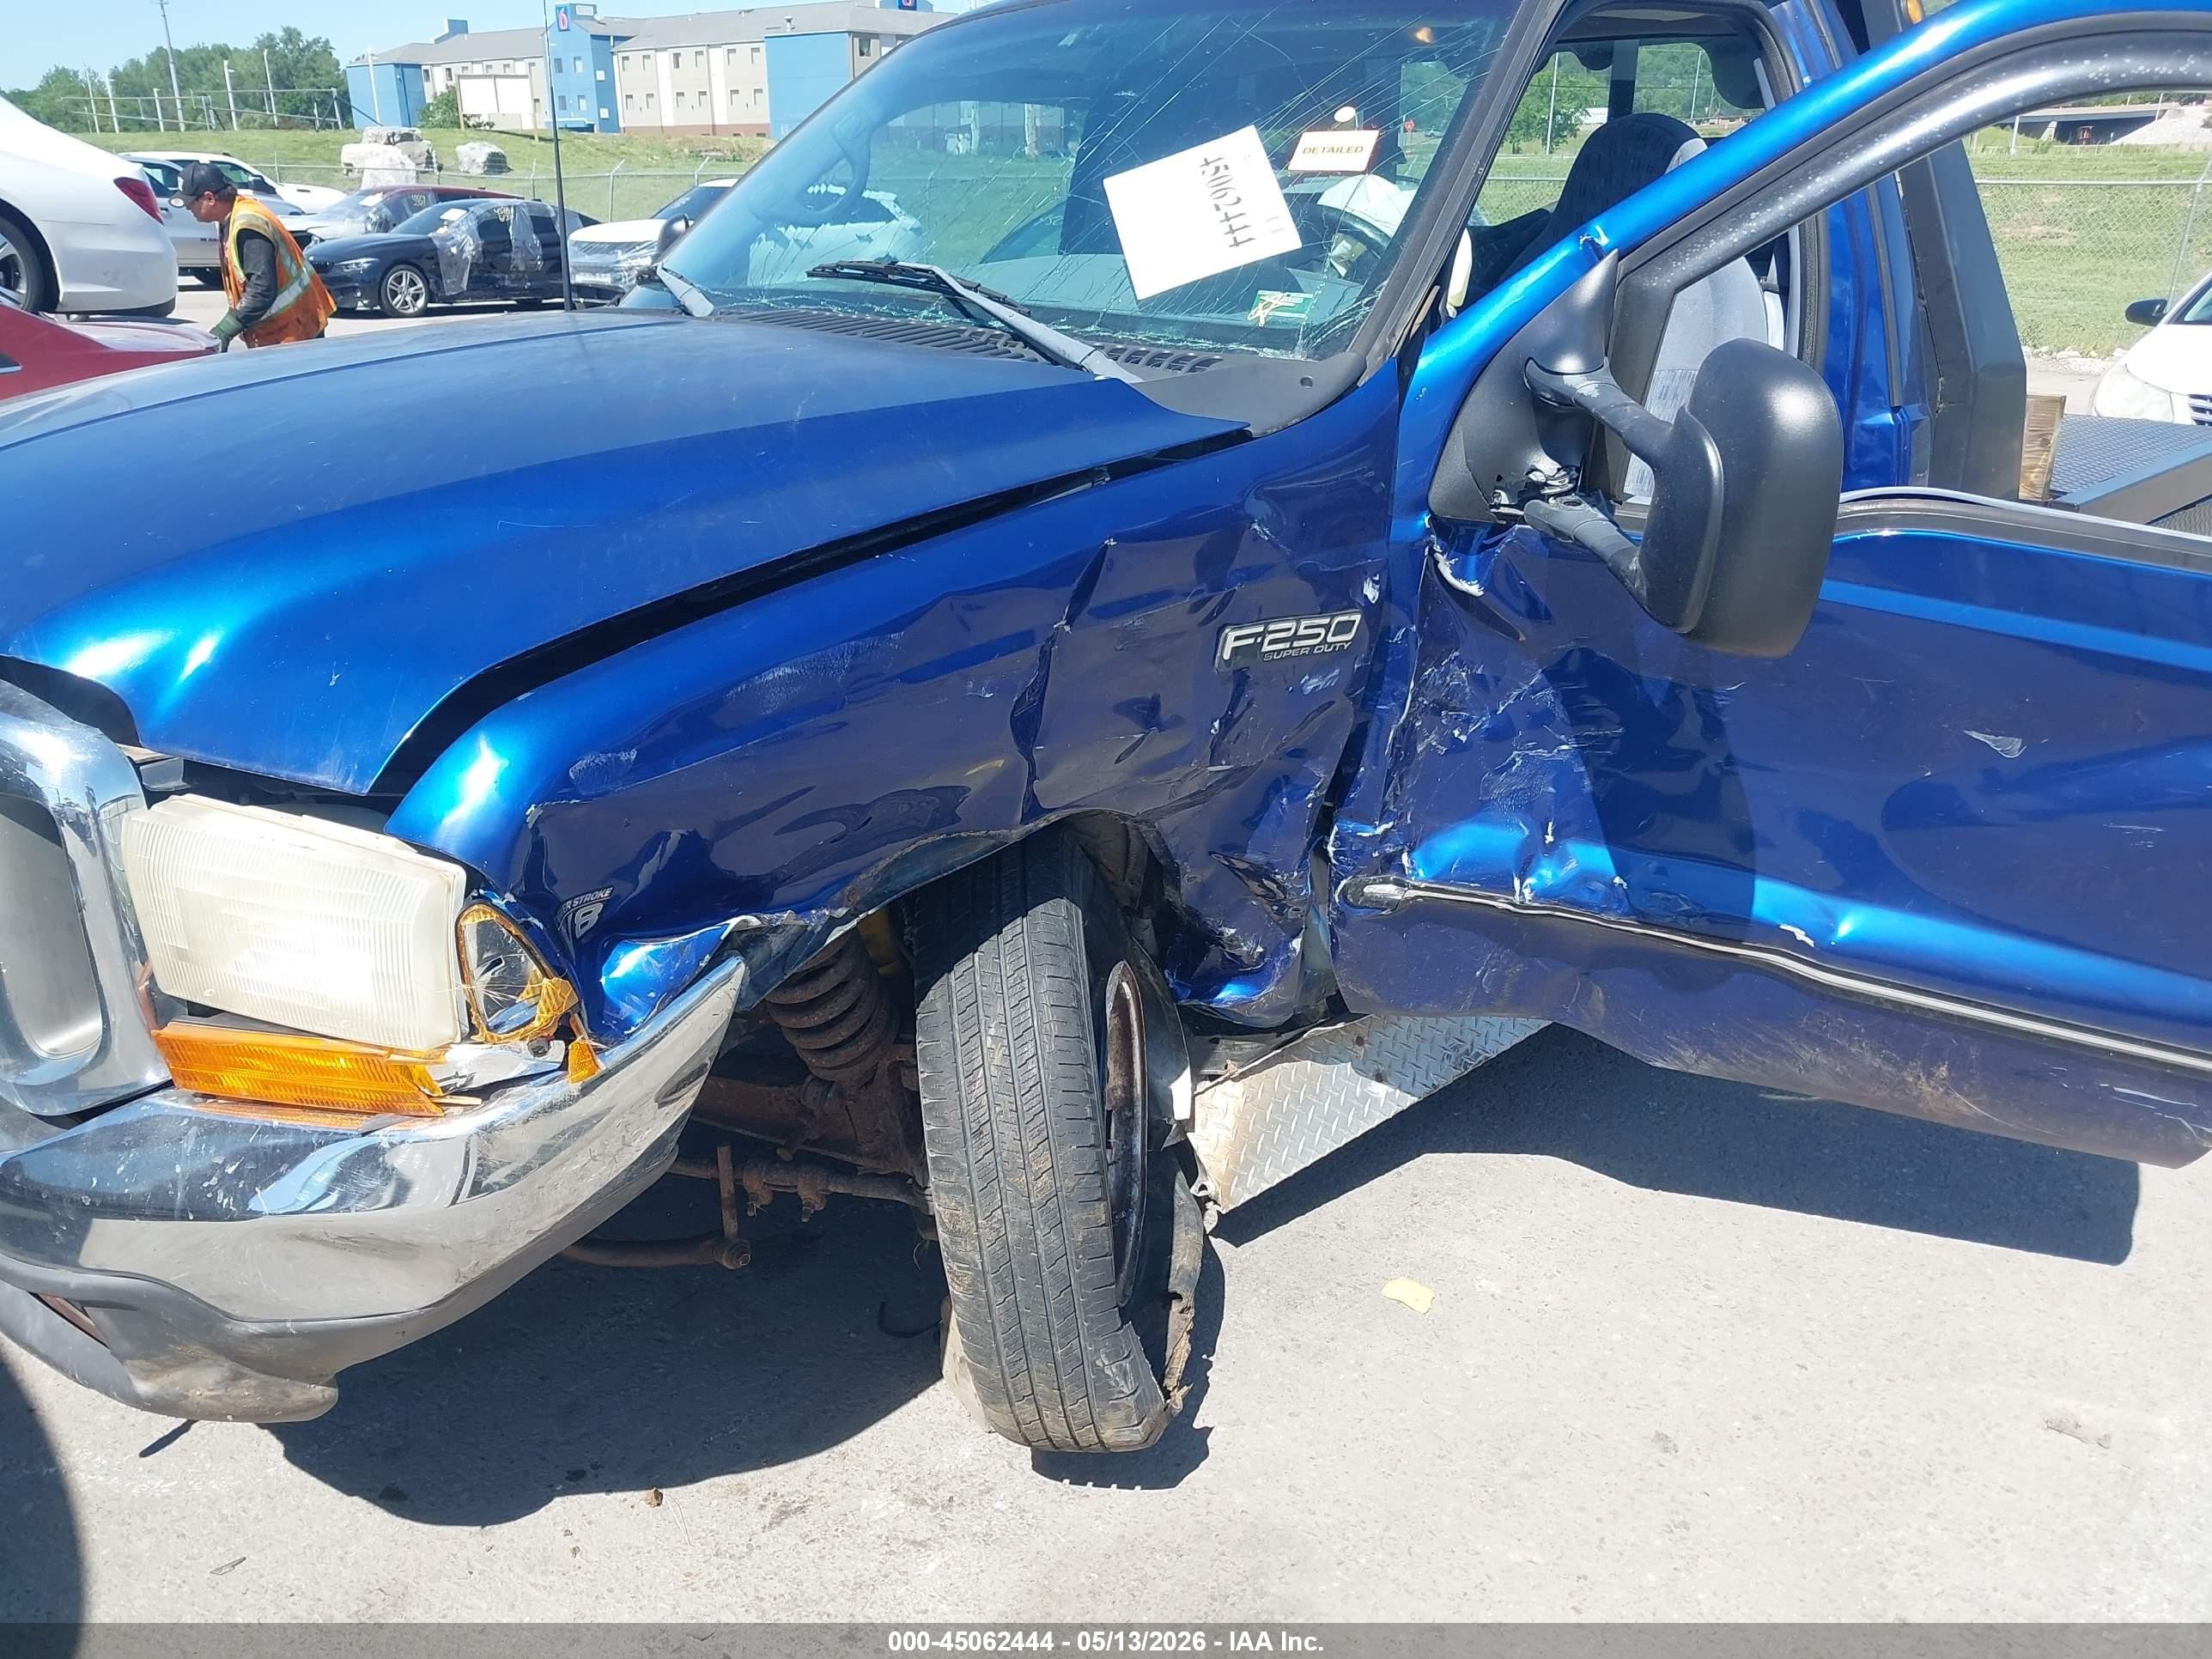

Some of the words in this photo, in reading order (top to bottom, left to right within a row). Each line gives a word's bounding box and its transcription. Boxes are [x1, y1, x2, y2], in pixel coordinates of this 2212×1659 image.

[1302, 145, 1364, 155] DETAILED
[1199, 156, 1256, 248] 45062444
[1222, 612, 1362, 660] F-250
[1263, 647, 1310, 661] SUPER
[1313, 641, 1352, 654] DUTY
[573, 887, 613, 908] STROKE
